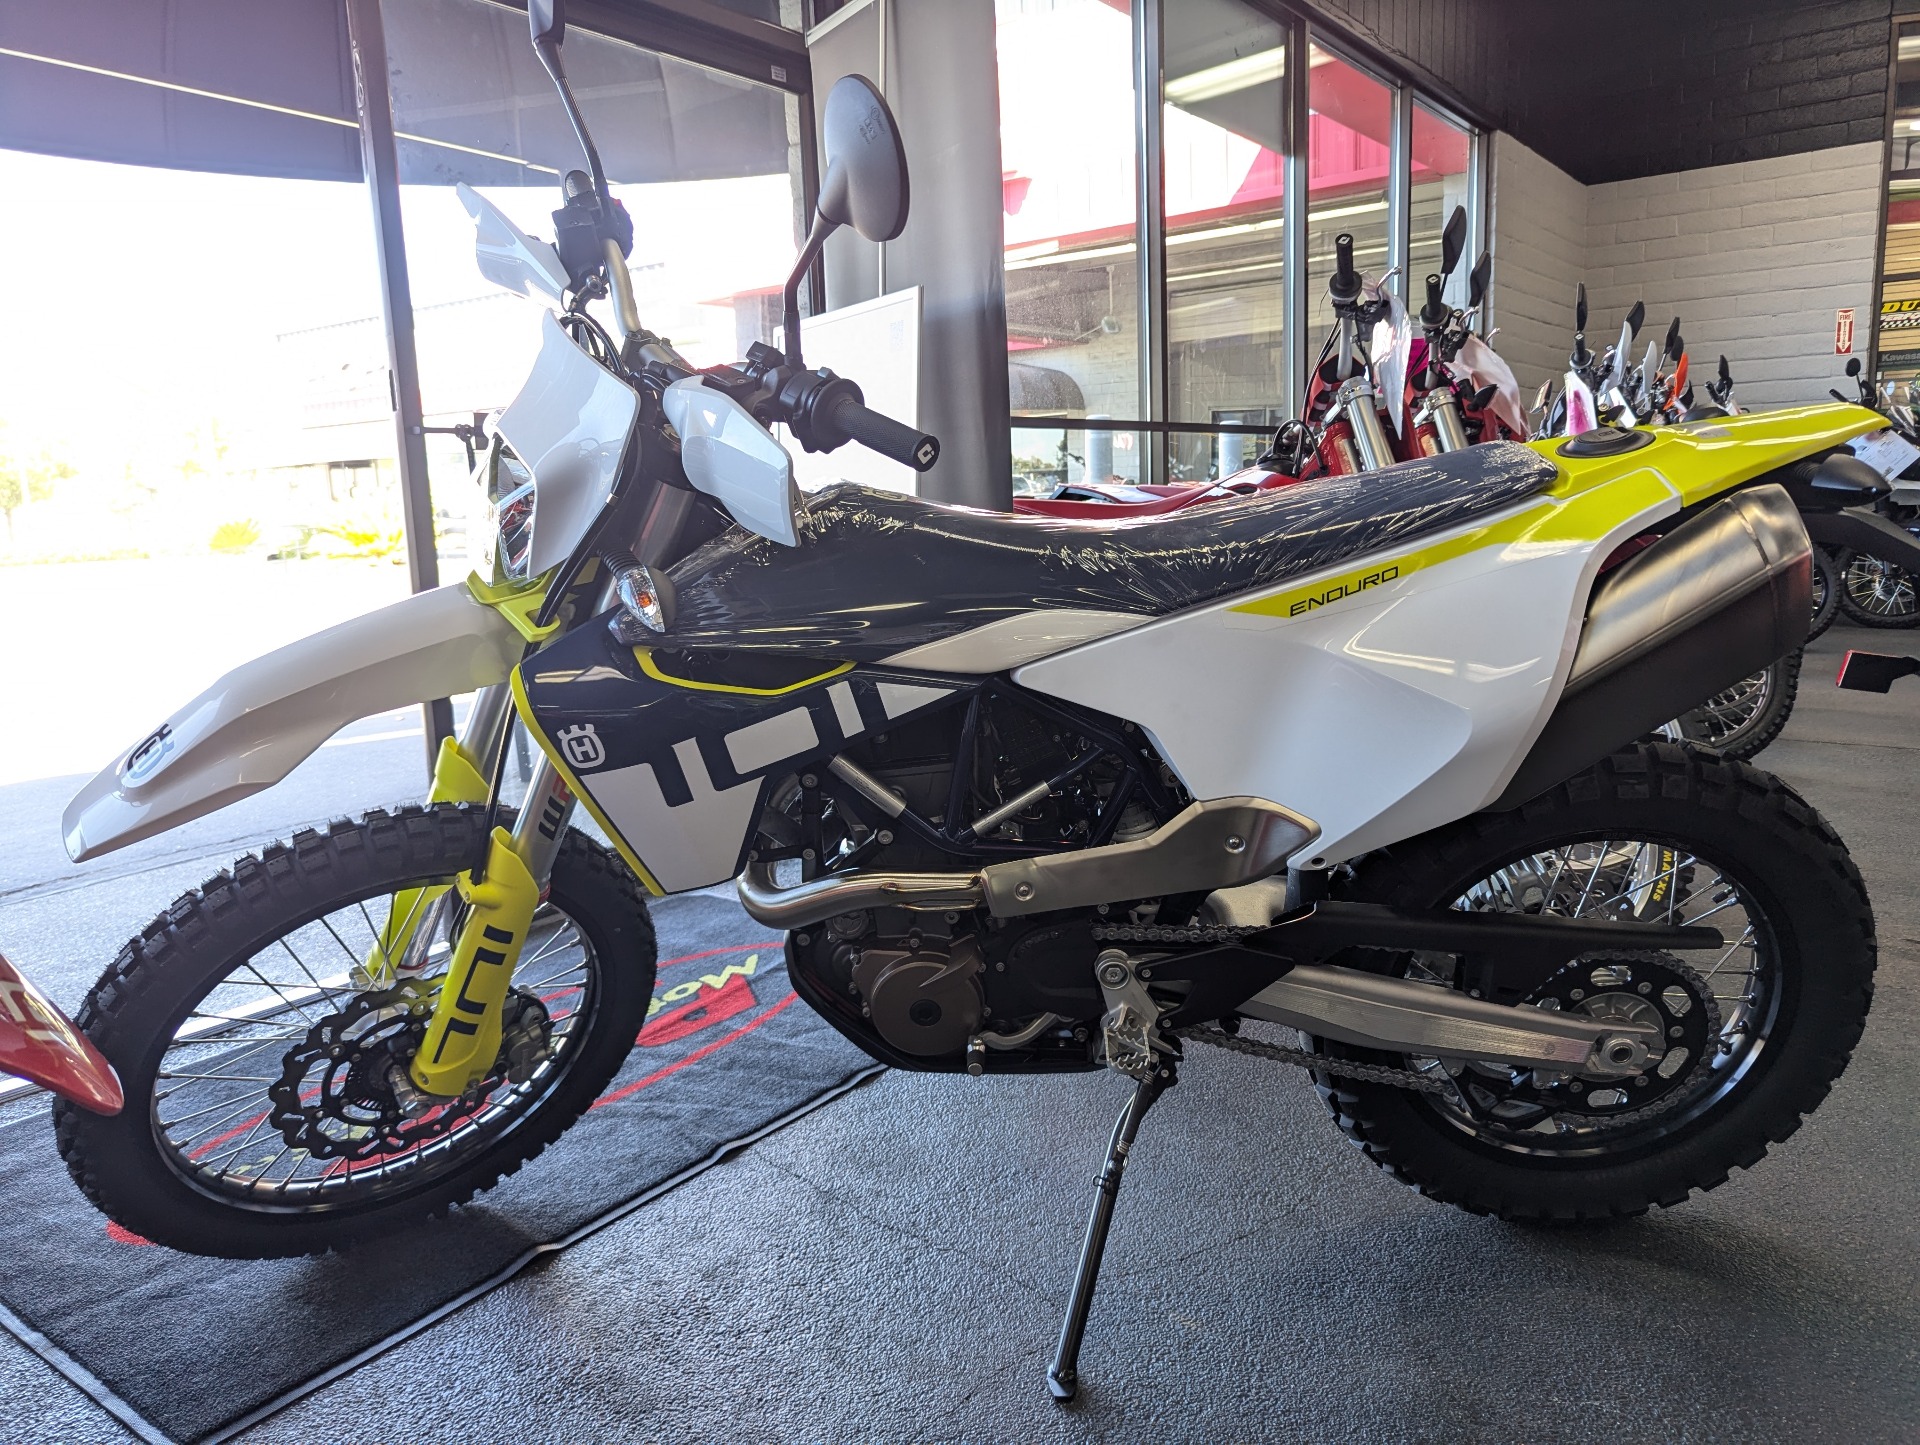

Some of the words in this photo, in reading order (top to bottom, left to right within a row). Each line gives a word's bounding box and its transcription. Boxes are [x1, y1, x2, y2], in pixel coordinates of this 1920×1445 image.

[1880, 300, 1920, 313] DU
[1289, 565, 1399, 617] ENDURO
[1652, 850, 1673, 902] MAXXIS
